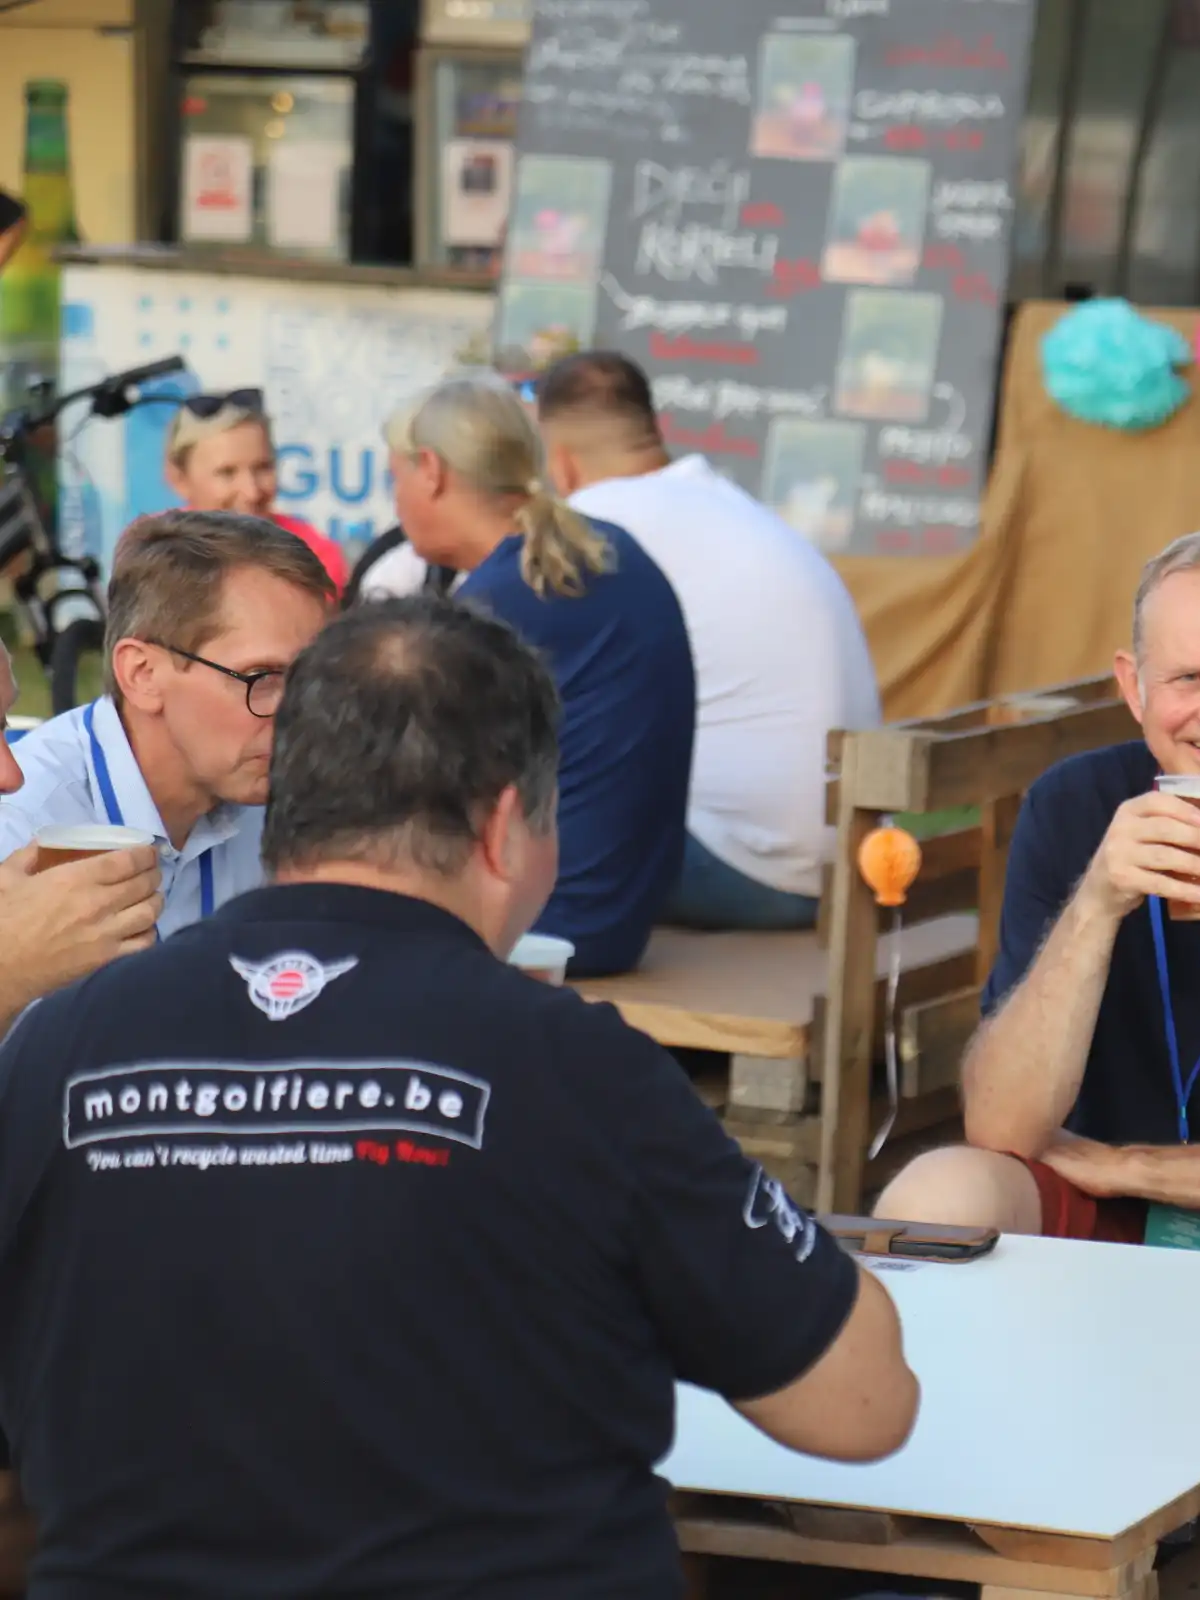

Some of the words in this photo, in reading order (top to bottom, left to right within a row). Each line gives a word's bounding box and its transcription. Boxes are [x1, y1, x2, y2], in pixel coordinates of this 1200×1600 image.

[84, 1073, 463, 1121] montgolfiere.be
[87, 1149, 121, 1171] You
[124, 1142, 170, 1167] can't
[172, 1143, 236, 1171] recycle
[239, 1140, 307, 1166] wasted
[310, 1140, 354, 1164] time
